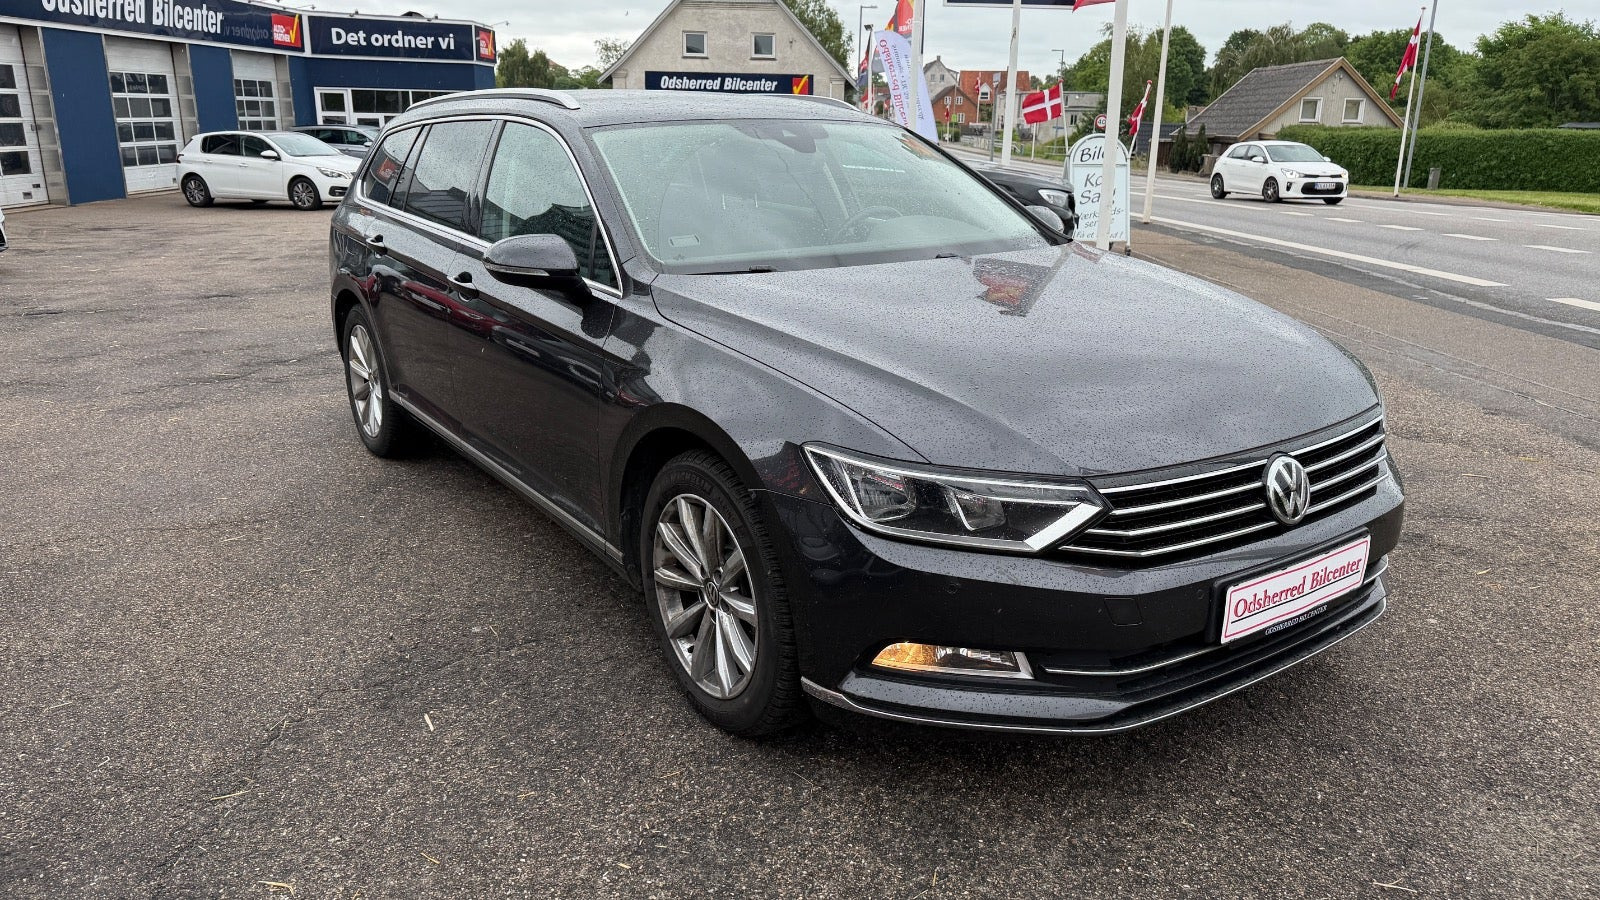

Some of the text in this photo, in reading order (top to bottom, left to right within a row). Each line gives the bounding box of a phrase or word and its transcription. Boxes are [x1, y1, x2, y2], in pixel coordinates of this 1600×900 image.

[152, 0, 223, 34] Bilcenter
[331, 27, 455, 50] Det ordner vi
[660, 75, 778, 91] Odsherred Bilcenter
[1233, 558, 1362, 618] Odsherred Bilcenter
